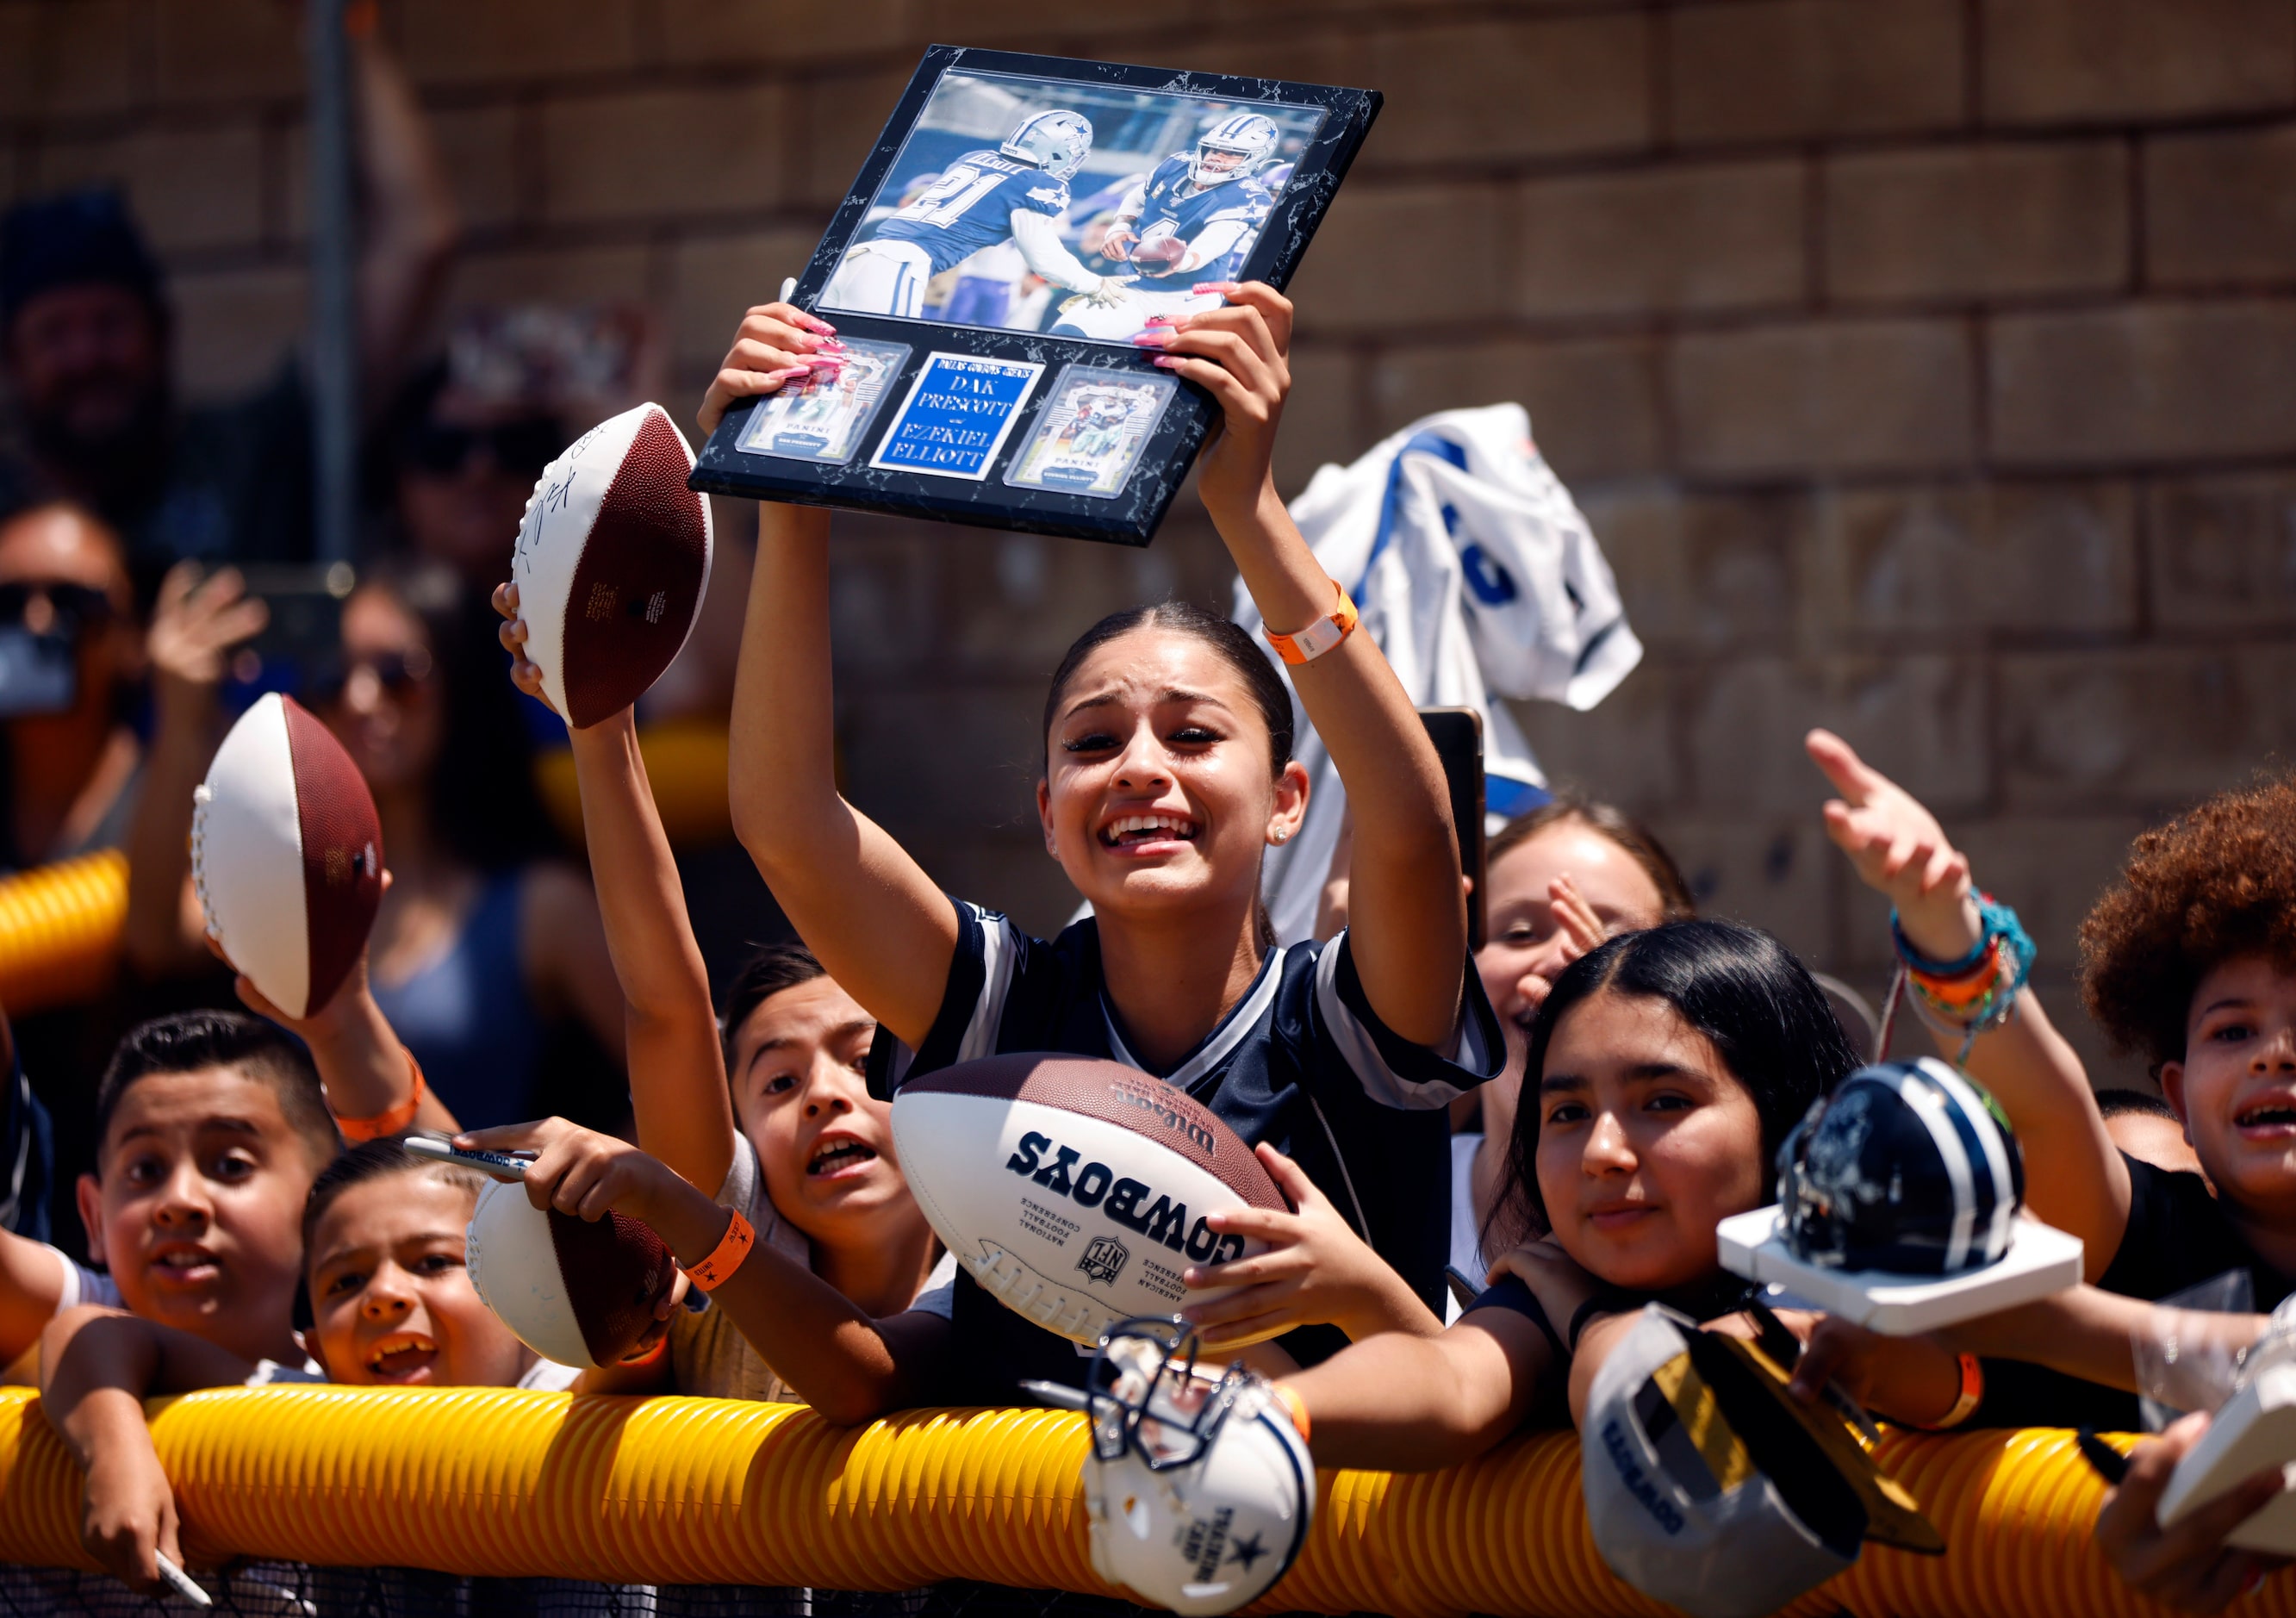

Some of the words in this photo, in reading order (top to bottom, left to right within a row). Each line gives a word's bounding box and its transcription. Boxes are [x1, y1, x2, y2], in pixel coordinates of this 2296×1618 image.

[889, 165, 1008, 229] 21
[949, 375, 999, 395] DAK
[918, 392, 1012, 417] PRESCOTT
[786, 423, 831, 433] PANINI
[900, 422, 990, 447] EZEKIEL
[890, 441, 985, 467] ELLIOTT
[1055, 457, 1100, 468] PANINI
[1113, 1087, 1216, 1157] Wilson
[1020, 1197, 1080, 1233] CONFERENCE
[1023, 1210, 1070, 1239] FOOTBALL
[1019, 1218, 1065, 1247] NATIONAL
[1092, 1242, 1123, 1269] NFL
[694, 1261, 714, 1276] UNITED
[1137, 1279, 1182, 1303] AMERICAN
[1144, 1270, 1187, 1295] FOOTBALL
